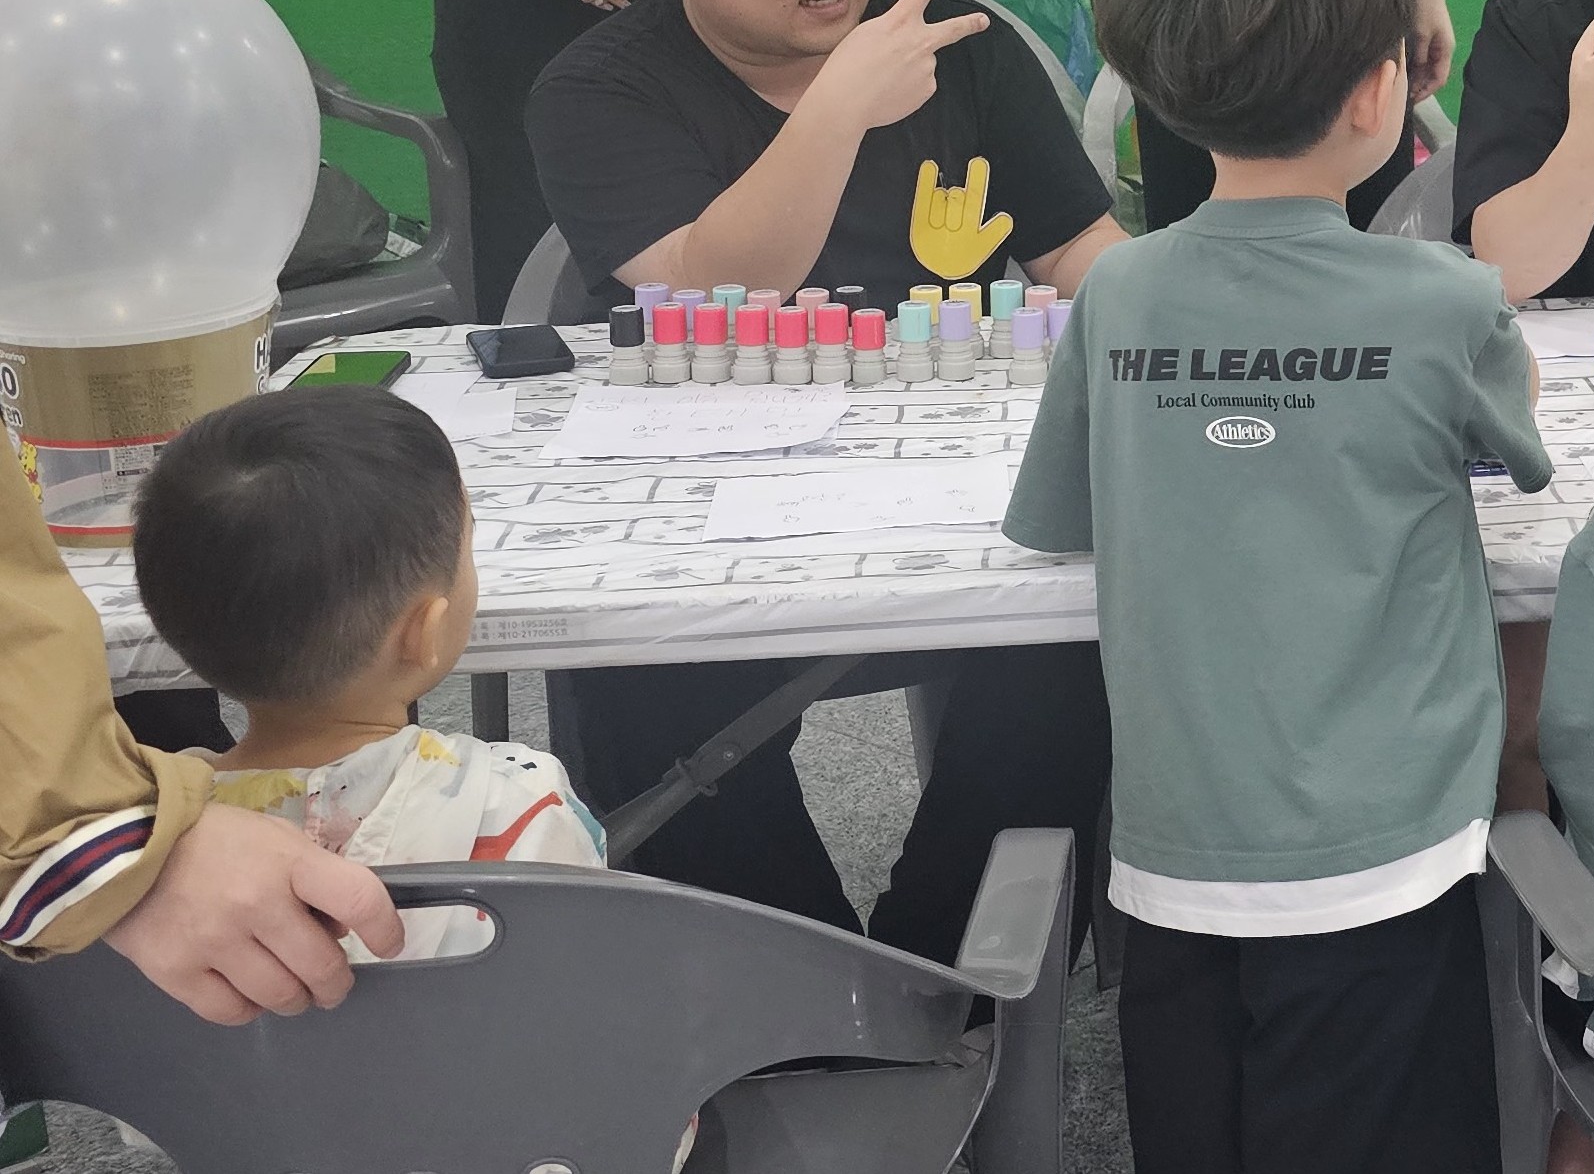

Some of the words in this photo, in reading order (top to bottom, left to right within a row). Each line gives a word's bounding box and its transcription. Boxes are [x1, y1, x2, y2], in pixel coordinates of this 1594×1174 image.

[1108, 348, 1180, 382] THE
[1189, 346, 1393, 382] LEAGUE
[1156, 393, 1197, 409] Local
[1200, 393, 1280, 411] Community
[1283, 393, 1316, 409] Club
[1211, 423, 1272, 441] Athletics
